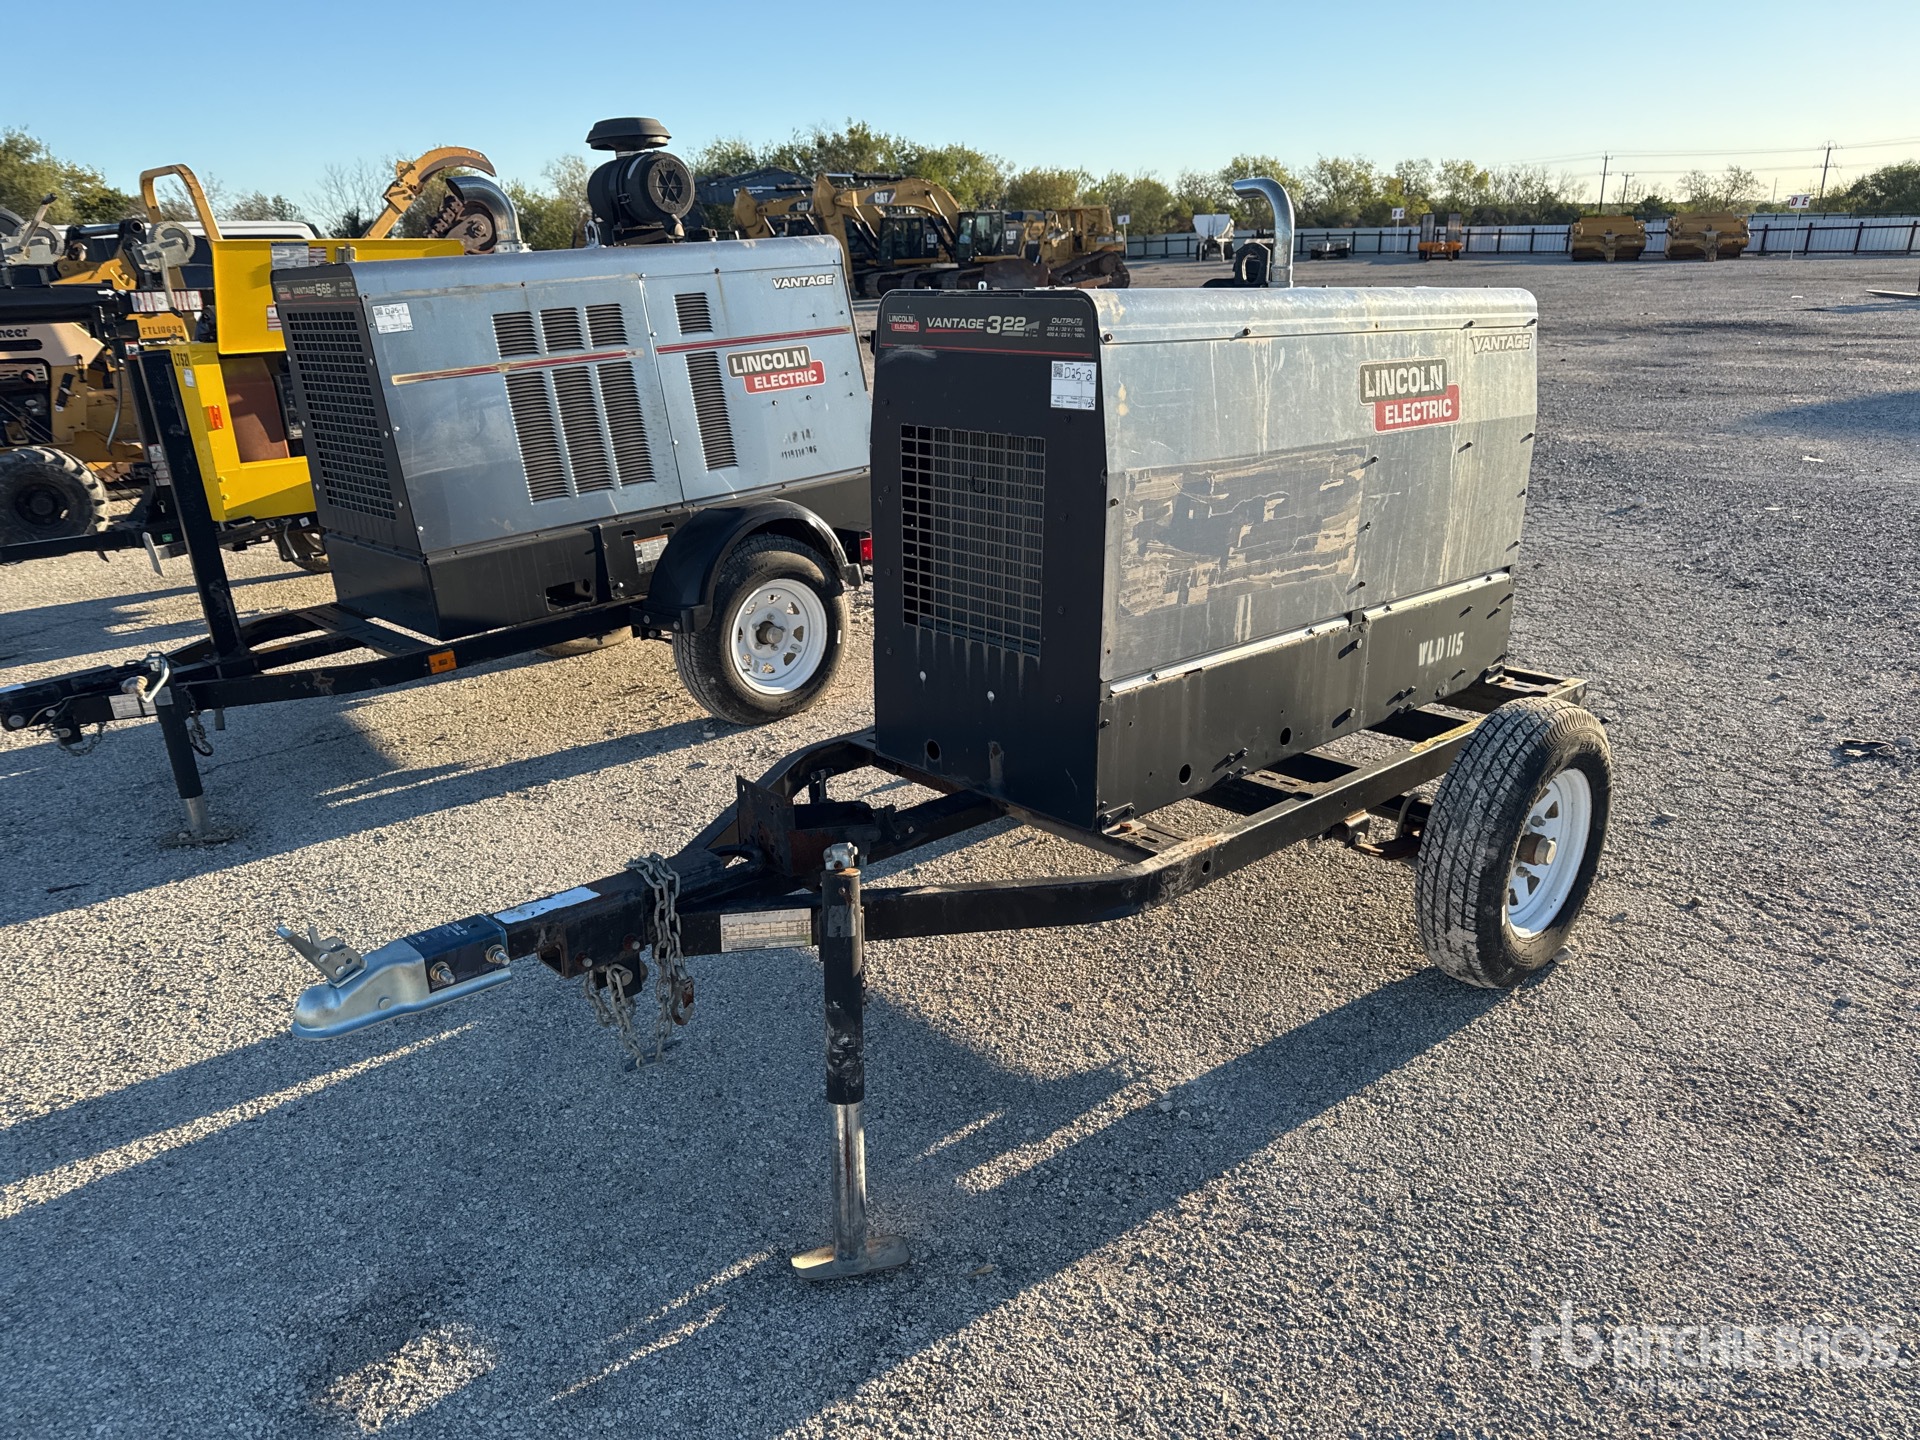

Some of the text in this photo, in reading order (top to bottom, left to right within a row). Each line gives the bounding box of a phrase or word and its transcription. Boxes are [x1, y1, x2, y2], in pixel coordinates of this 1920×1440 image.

[874, 192, 888, 204] CAT
[1791, 196, 1809, 206] D E
[796, 201, 808, 211] CAT
[926, 234, 937, 243] CAT
[1006, 231, 1017, 240] CAT
[772, 274, 834, 289] VANTAGE
[292, 285, 315, 295] VANTAGE
[315, 283, 330, 296] 566
[888, 314, 914, 323] LINCOLN
[927, 315, 1027, 334] VANTAGE 322
[894, 323, 916, 331] ELECTRIC
[1473, 334, 1532, 353] VANTAGE
[732, 350, 807, 374] LINCOLN
[753, 370, 818, 389] ELECTRIC
[1064, 366, 1093, 381] D25-2
[1365, 365, 1443, 398] LINCOLN
[1385, 399, 1452, 425] ELECTRIC
[1418, 631, 1465, 666] WLD 115
